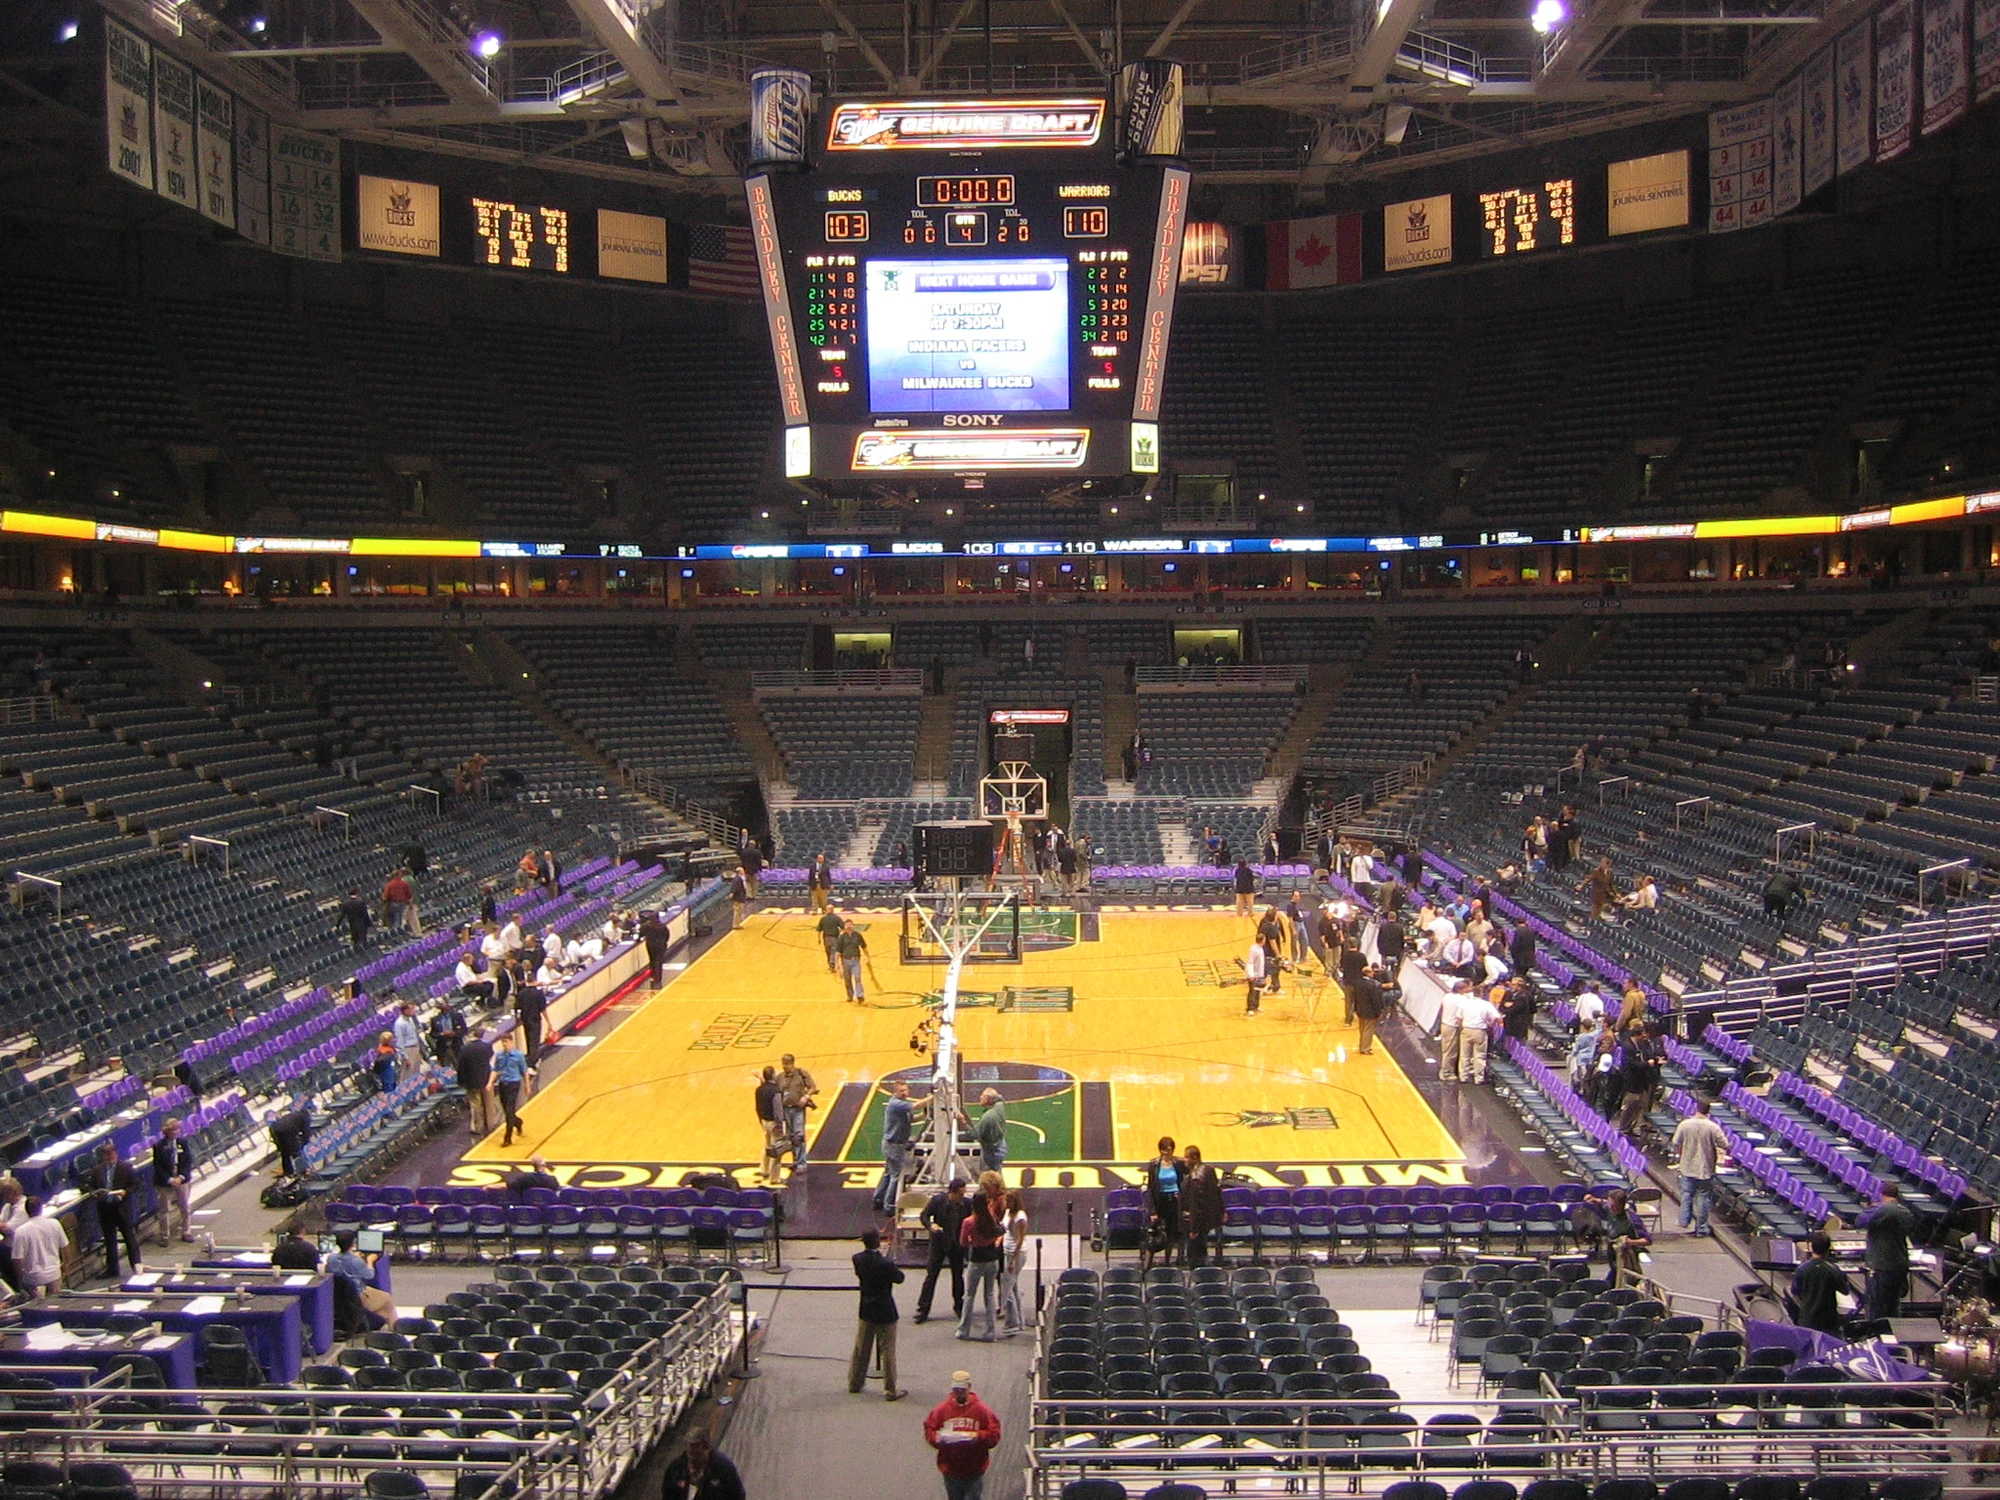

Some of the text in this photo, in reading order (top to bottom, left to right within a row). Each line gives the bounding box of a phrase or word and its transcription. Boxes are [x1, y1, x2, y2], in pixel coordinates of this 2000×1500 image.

[1133, 84, 1153, 144] DRAFT
[900, 115, 1003, 135] GENUINE
[1008, 114, 1090, 132] DRAFT
[937, 180, 1010, 202] 0:00.0
[1059, 185, 1110, 197] WARRIORS
[1545, 180, 1572, 191] Bucks
[828, 190, 862, 201] BUCKS
[1480, 189, 1520, 203] Warriors
[1485, 188, 1572, 210] 50.0 47.9
[1611, 186, 1685, 208] JOURNAL SENTINEL
[473, 198, 515, 212] Warriors
[478, 208, 500, 218] 50.0
[546, 217, 567, 227] 47.9
[540, 207, 567, 218] Bucks
[829, 215, 864, 237] 103
[956, 216, 975, 225] QTR
[1068, 211, 1104, 233] 110
[904, 228, 935, 243] 0 0
[962, 228, 971, 241] 4
[998, 226, 1029, 242] 2 0
[362, 231, 438, 251] www.bucks.com
[807, 257, 824, 266] PLR
[838, 256, 856, 266] PTS
[1079, 252, 1095, 261] PLR
[1111, 251, 1128, 261] PTS
[1386, 246, 1450, 266] www.bucks.com
[812, 273, 824, 283] 11
[920, 274, 1037, 287] NEXT HOME GAME
[808, 289, 824, 299] 21
[1116, 284, 1127, 294] 14
[1140, 178, 1182, 412] BRADLEY CENTER
[753, 186, 802, 417] BRADLEY CENTER
[1112, 300, 1127, 310] 20
[809, 304, 824, 314] 22
[840, 304, 856, 314] 21
[931, 303, 1001, 316] SATURDAY
[810, 320, 825, 330] 25
[840, 320, 856, 330] 21
[930, 317, 1004, 330] AT 7:30PM
[1081, 316, 1096, 326] 23
[1112, 316, 1127, 326] 23
[810, 334, 825, 345] 42
[1082, 331, 1097, 342] 34
[1116, 331, 1127, 342] 10
[908, 339, 1026, 353] INDIANA PACERS
[1091, 346, 1116, 356] TEAM
[820, 351, 846, 360] TEAM
[834, 367, 842, 377] 5
[1104, 363, 1113, 373] 5
[818, 382, 849, 392] FOULS
[902, 376, 1034, 390] MILWAUKEE BUCKS
[1088, 378, 1120, 388] FOULS
[943, 414, 1003, 426] SONY
[1659, 524, 1694, 535] DRAFT
[892, 543, 943, 553] BUCKS
[963, 543, 994, 554] 103
[1065, 542, 1096, 553] 110
[1103, 541, 1183, 552] WARRIORS
[687, 1013, 753, 1051] BRADLEY
[731, 1015, 790, 1049] CENTER
